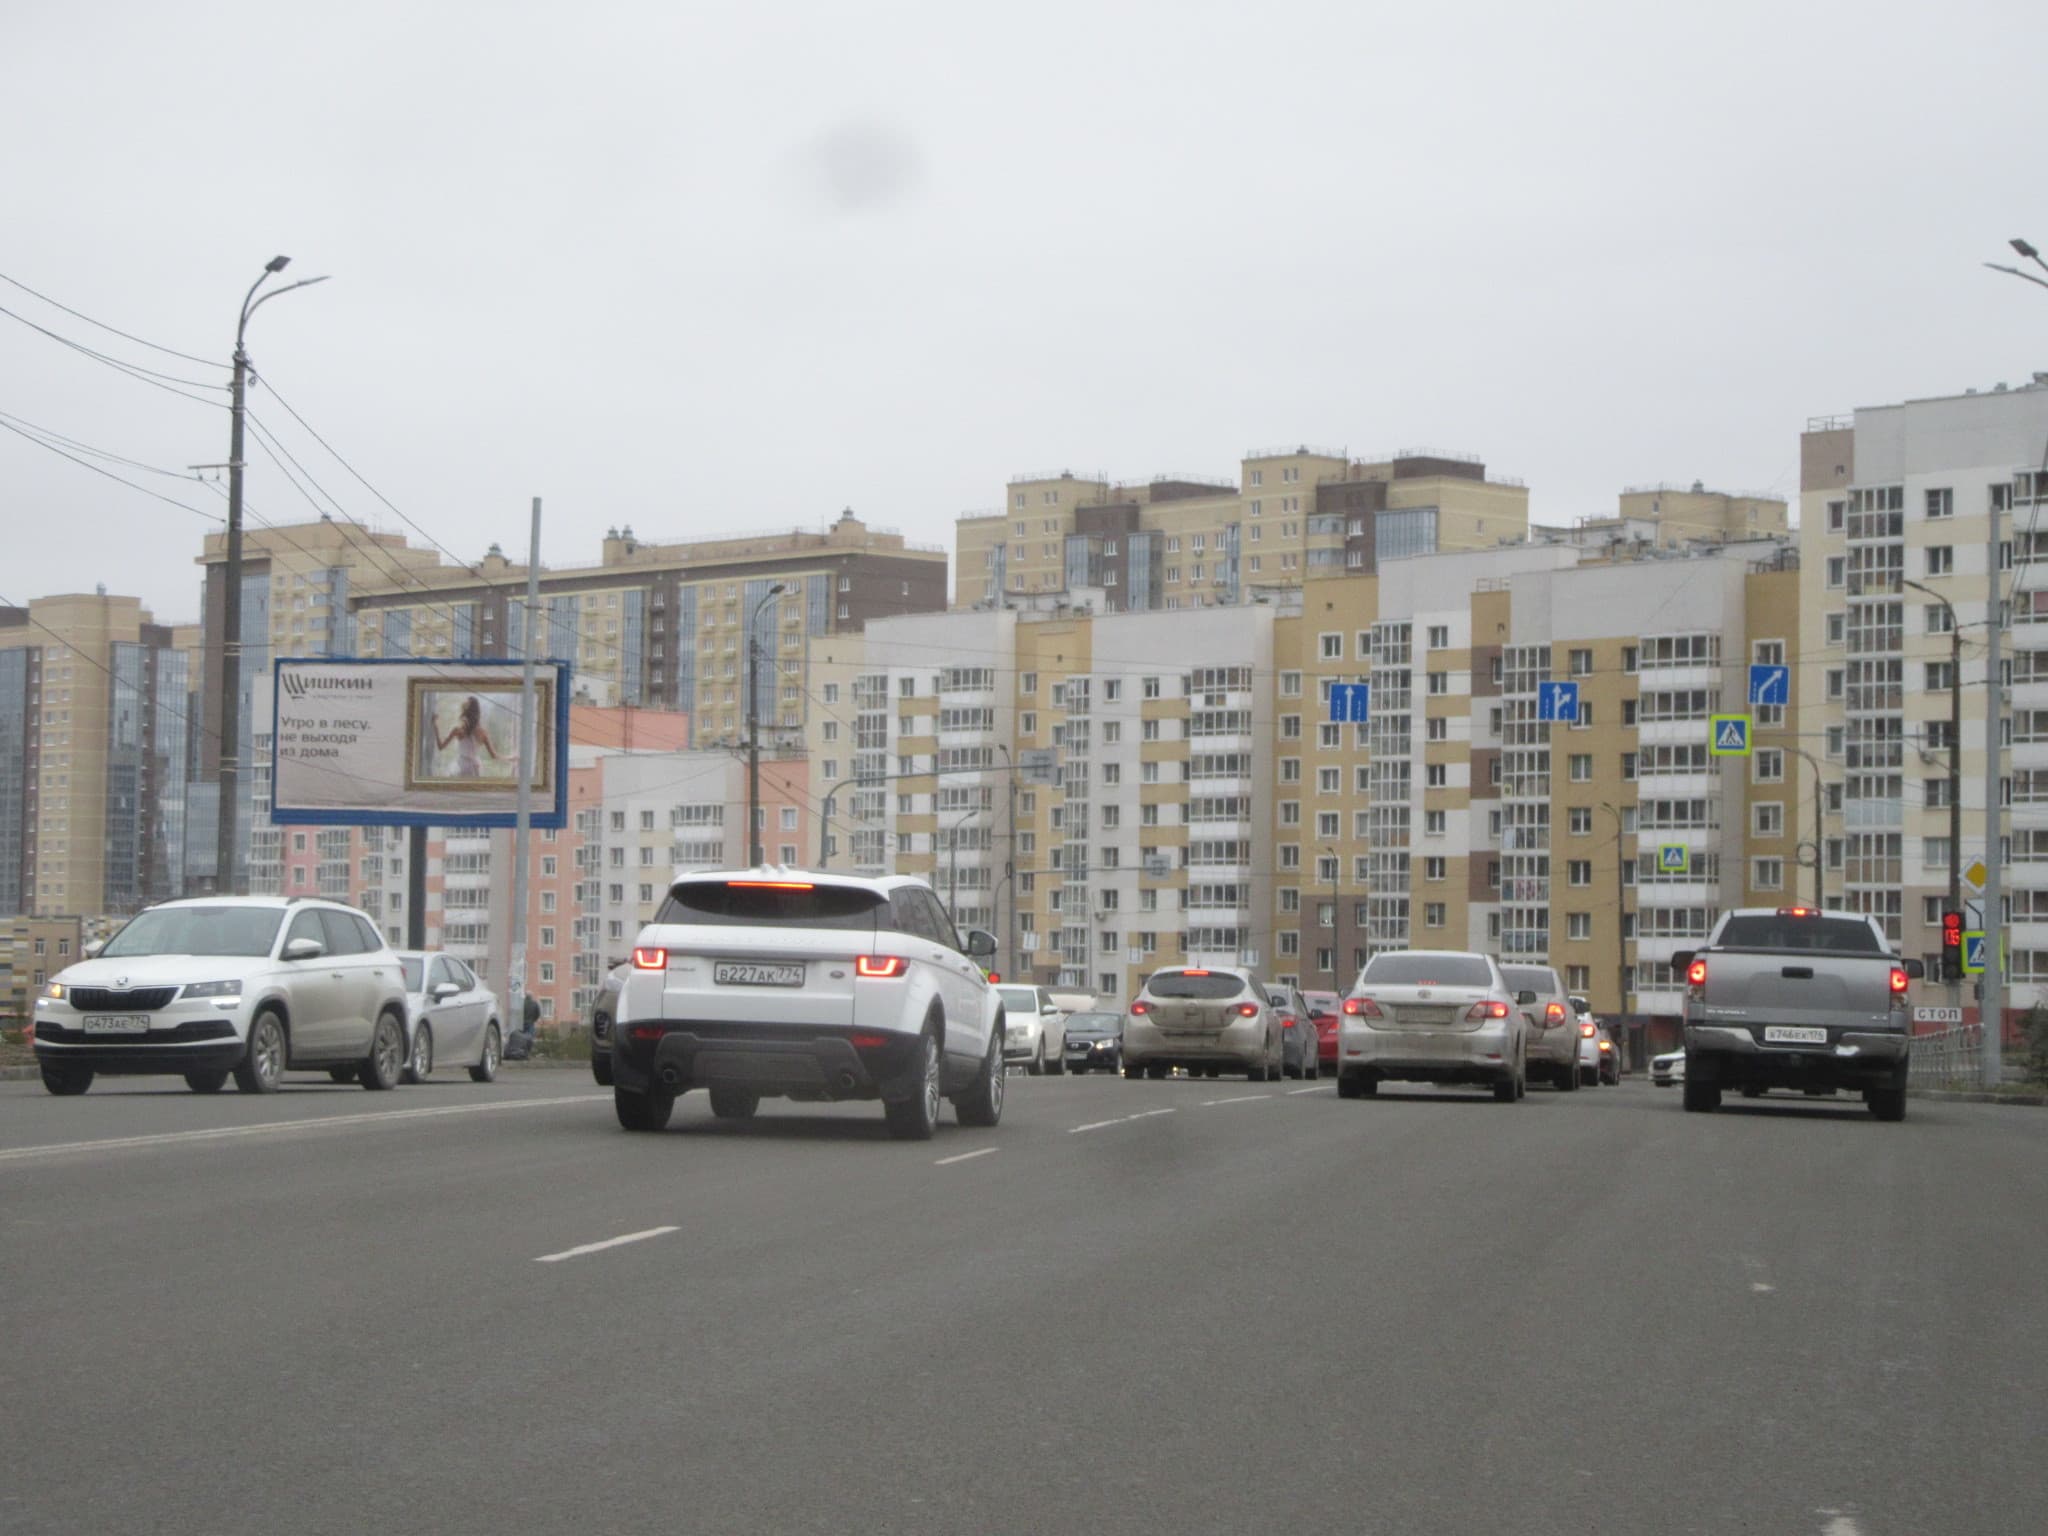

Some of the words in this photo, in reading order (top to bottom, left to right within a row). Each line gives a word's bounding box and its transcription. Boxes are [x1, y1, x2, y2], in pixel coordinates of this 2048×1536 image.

[281, 716, 315, 730] Утро
[319, 719, 328, 729] в
[281, 733, 297, 743] не
[301, 733, 358, 744] выходя
[281, 747, 296, 757] из
[300, 747, 340, 758] дома
[1918, 1008, 1958, 1020] СТОП
